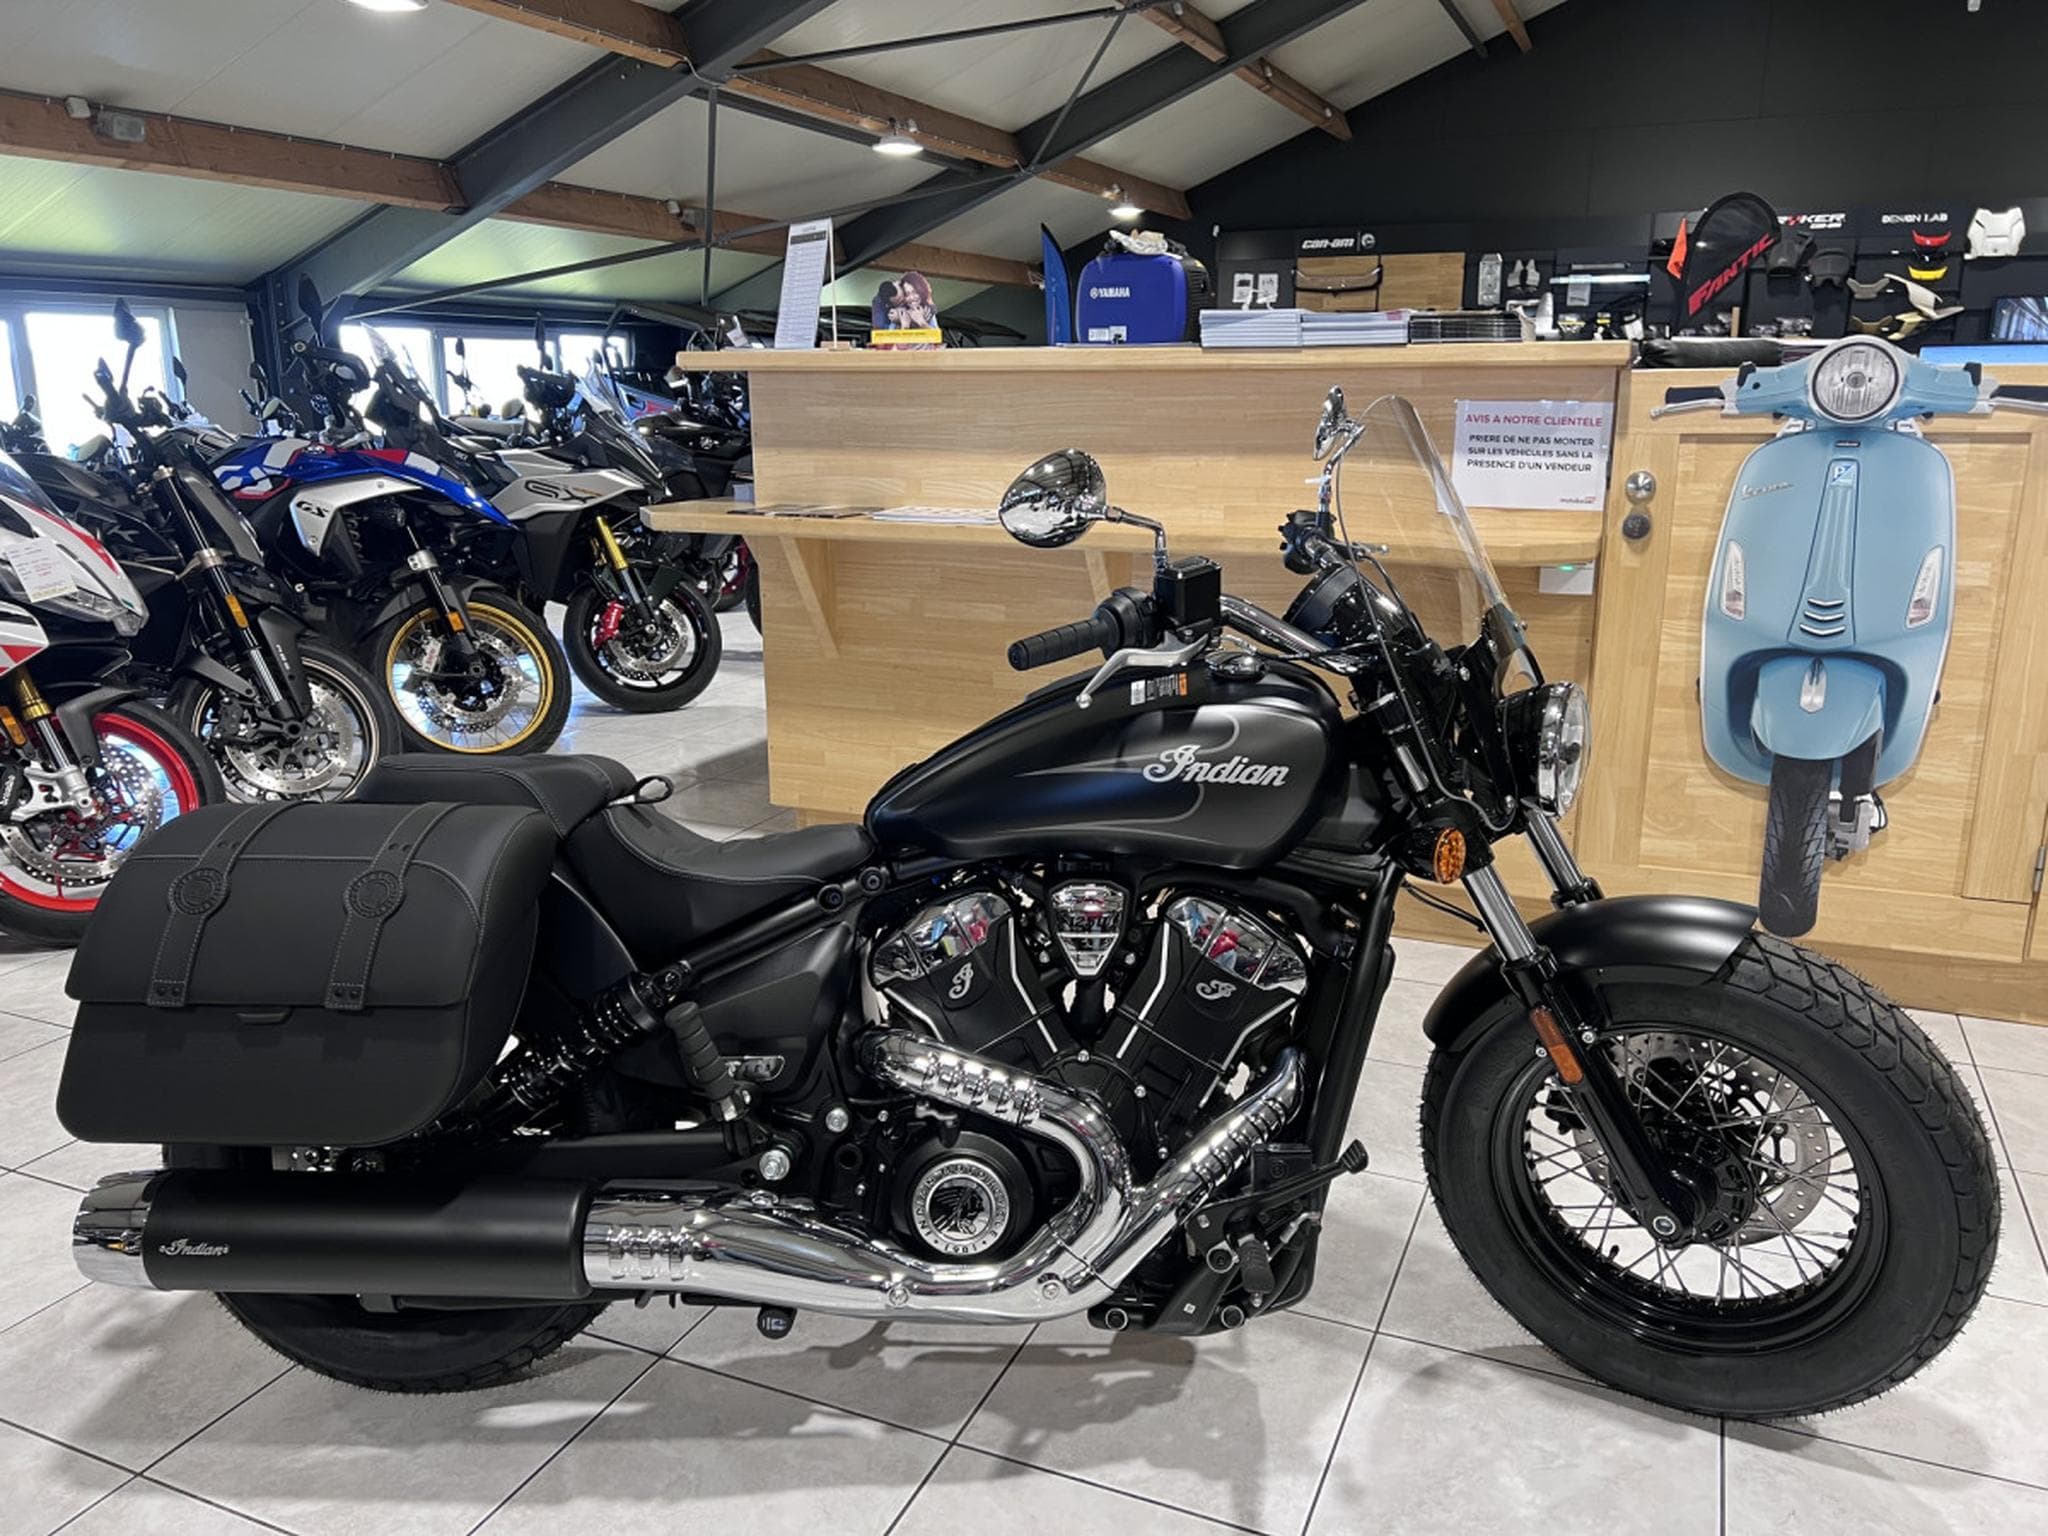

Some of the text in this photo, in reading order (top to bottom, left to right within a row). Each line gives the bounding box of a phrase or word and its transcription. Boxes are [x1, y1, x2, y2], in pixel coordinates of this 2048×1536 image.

[1688, 232, 1776, 317] FANTIC
[1099, 286, 1130, 298] YAMAHA
[1465, 414, 1491, 424] AVIS
[1503, 415, 1542, 426] NOTRE
[1502, 435, 1515, 444] DE
[1517, 436, 1531, 445] NE
[1532, 436, 1551, 445] PAS
[1553, 437, 1595, 446] MONTER
[1467, 447, 1487, 455] SUR
[1487, 448, 1502, 456] LES
[1555, 449, 1580, 459] SANS
[1581, 450, 1593, 460] LA
[1517, 460, 1542, 471] D'UN
[1545, 462, 1592, 472] VENDEUR
[296, 501, 329, 518] GS
[1143, 744, 1289, 786] Indian
[165, 1238, 222, 1256] Indian
